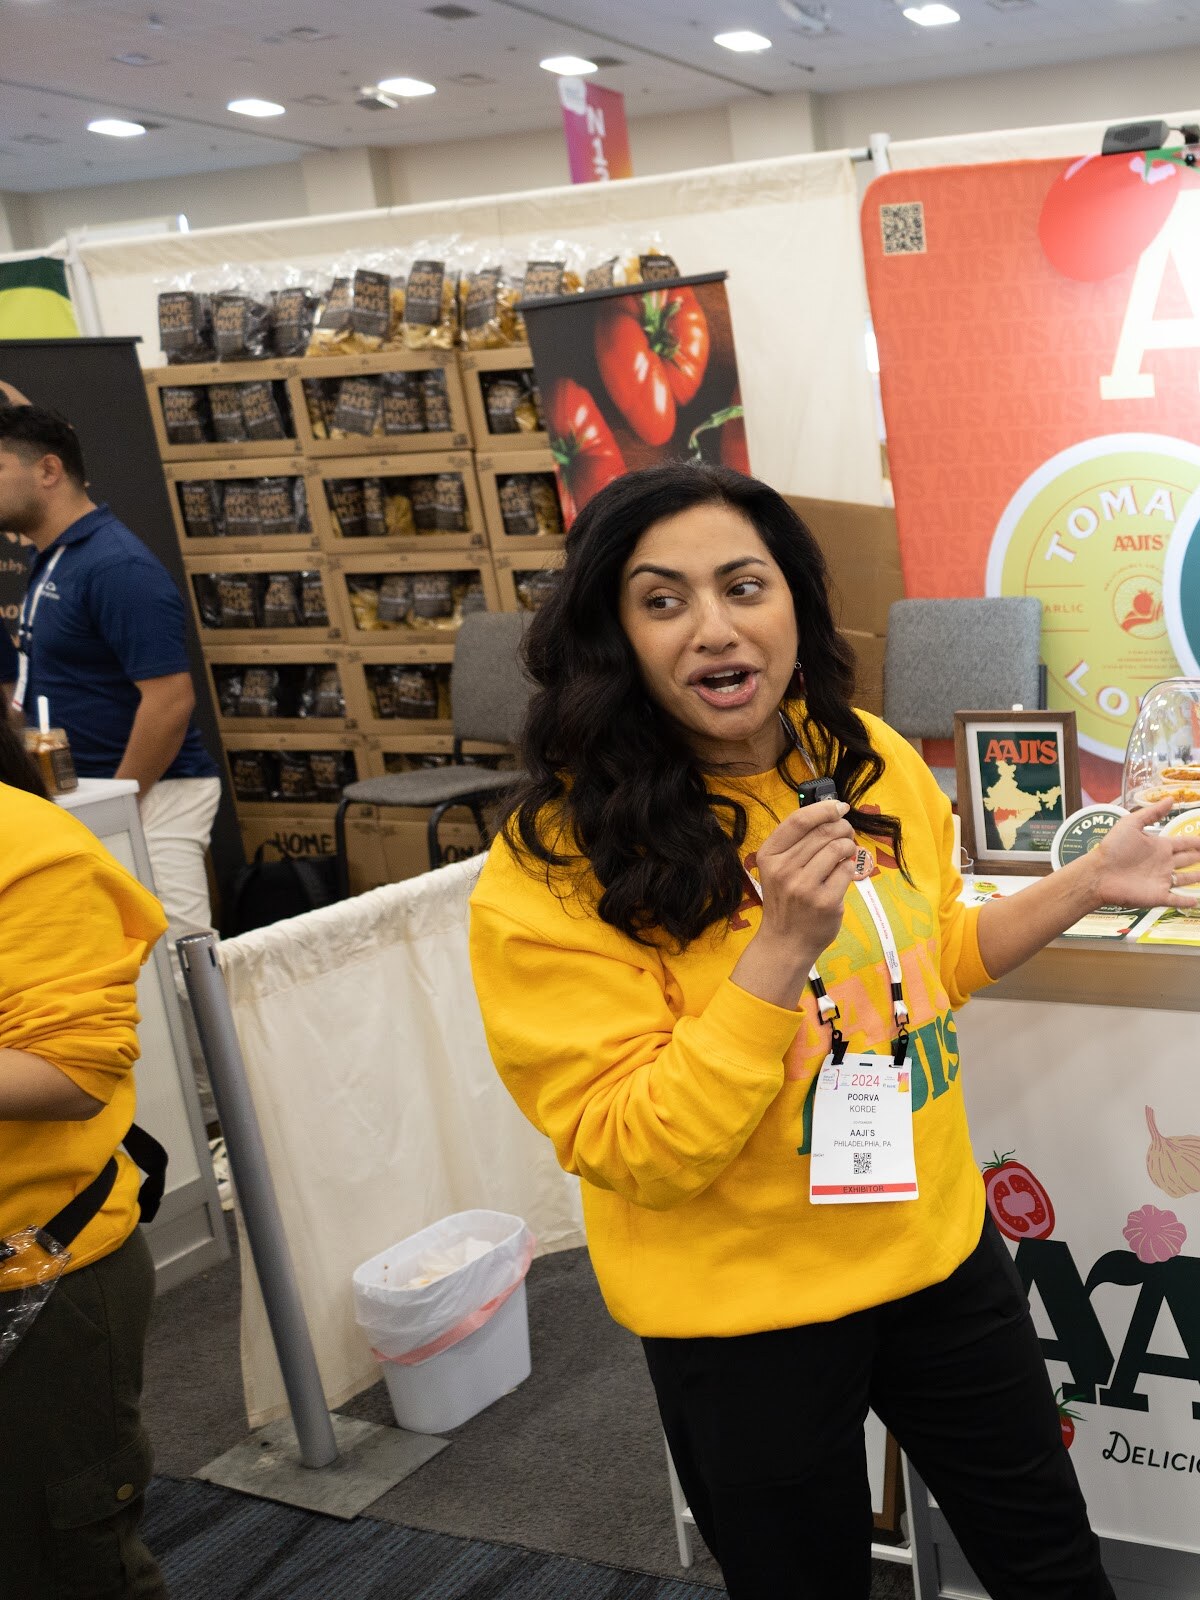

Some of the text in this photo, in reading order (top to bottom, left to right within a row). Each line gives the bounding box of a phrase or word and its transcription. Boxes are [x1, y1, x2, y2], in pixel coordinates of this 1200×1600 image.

[1045, 485, 1177, 564] TOMA
[1113, 534, 1164, 552] AAJI'S
[984, 739, 1058, 764] AAJI'S
[276, 831, 333, 856] HOME
[851, 1074, 880, 1087] 2024
[848, 1093, 880, 1101] POORVA
[849, 1105, 876, 1113] KORDE
[843, 1185, 884, 1194] EXHIBITOR
